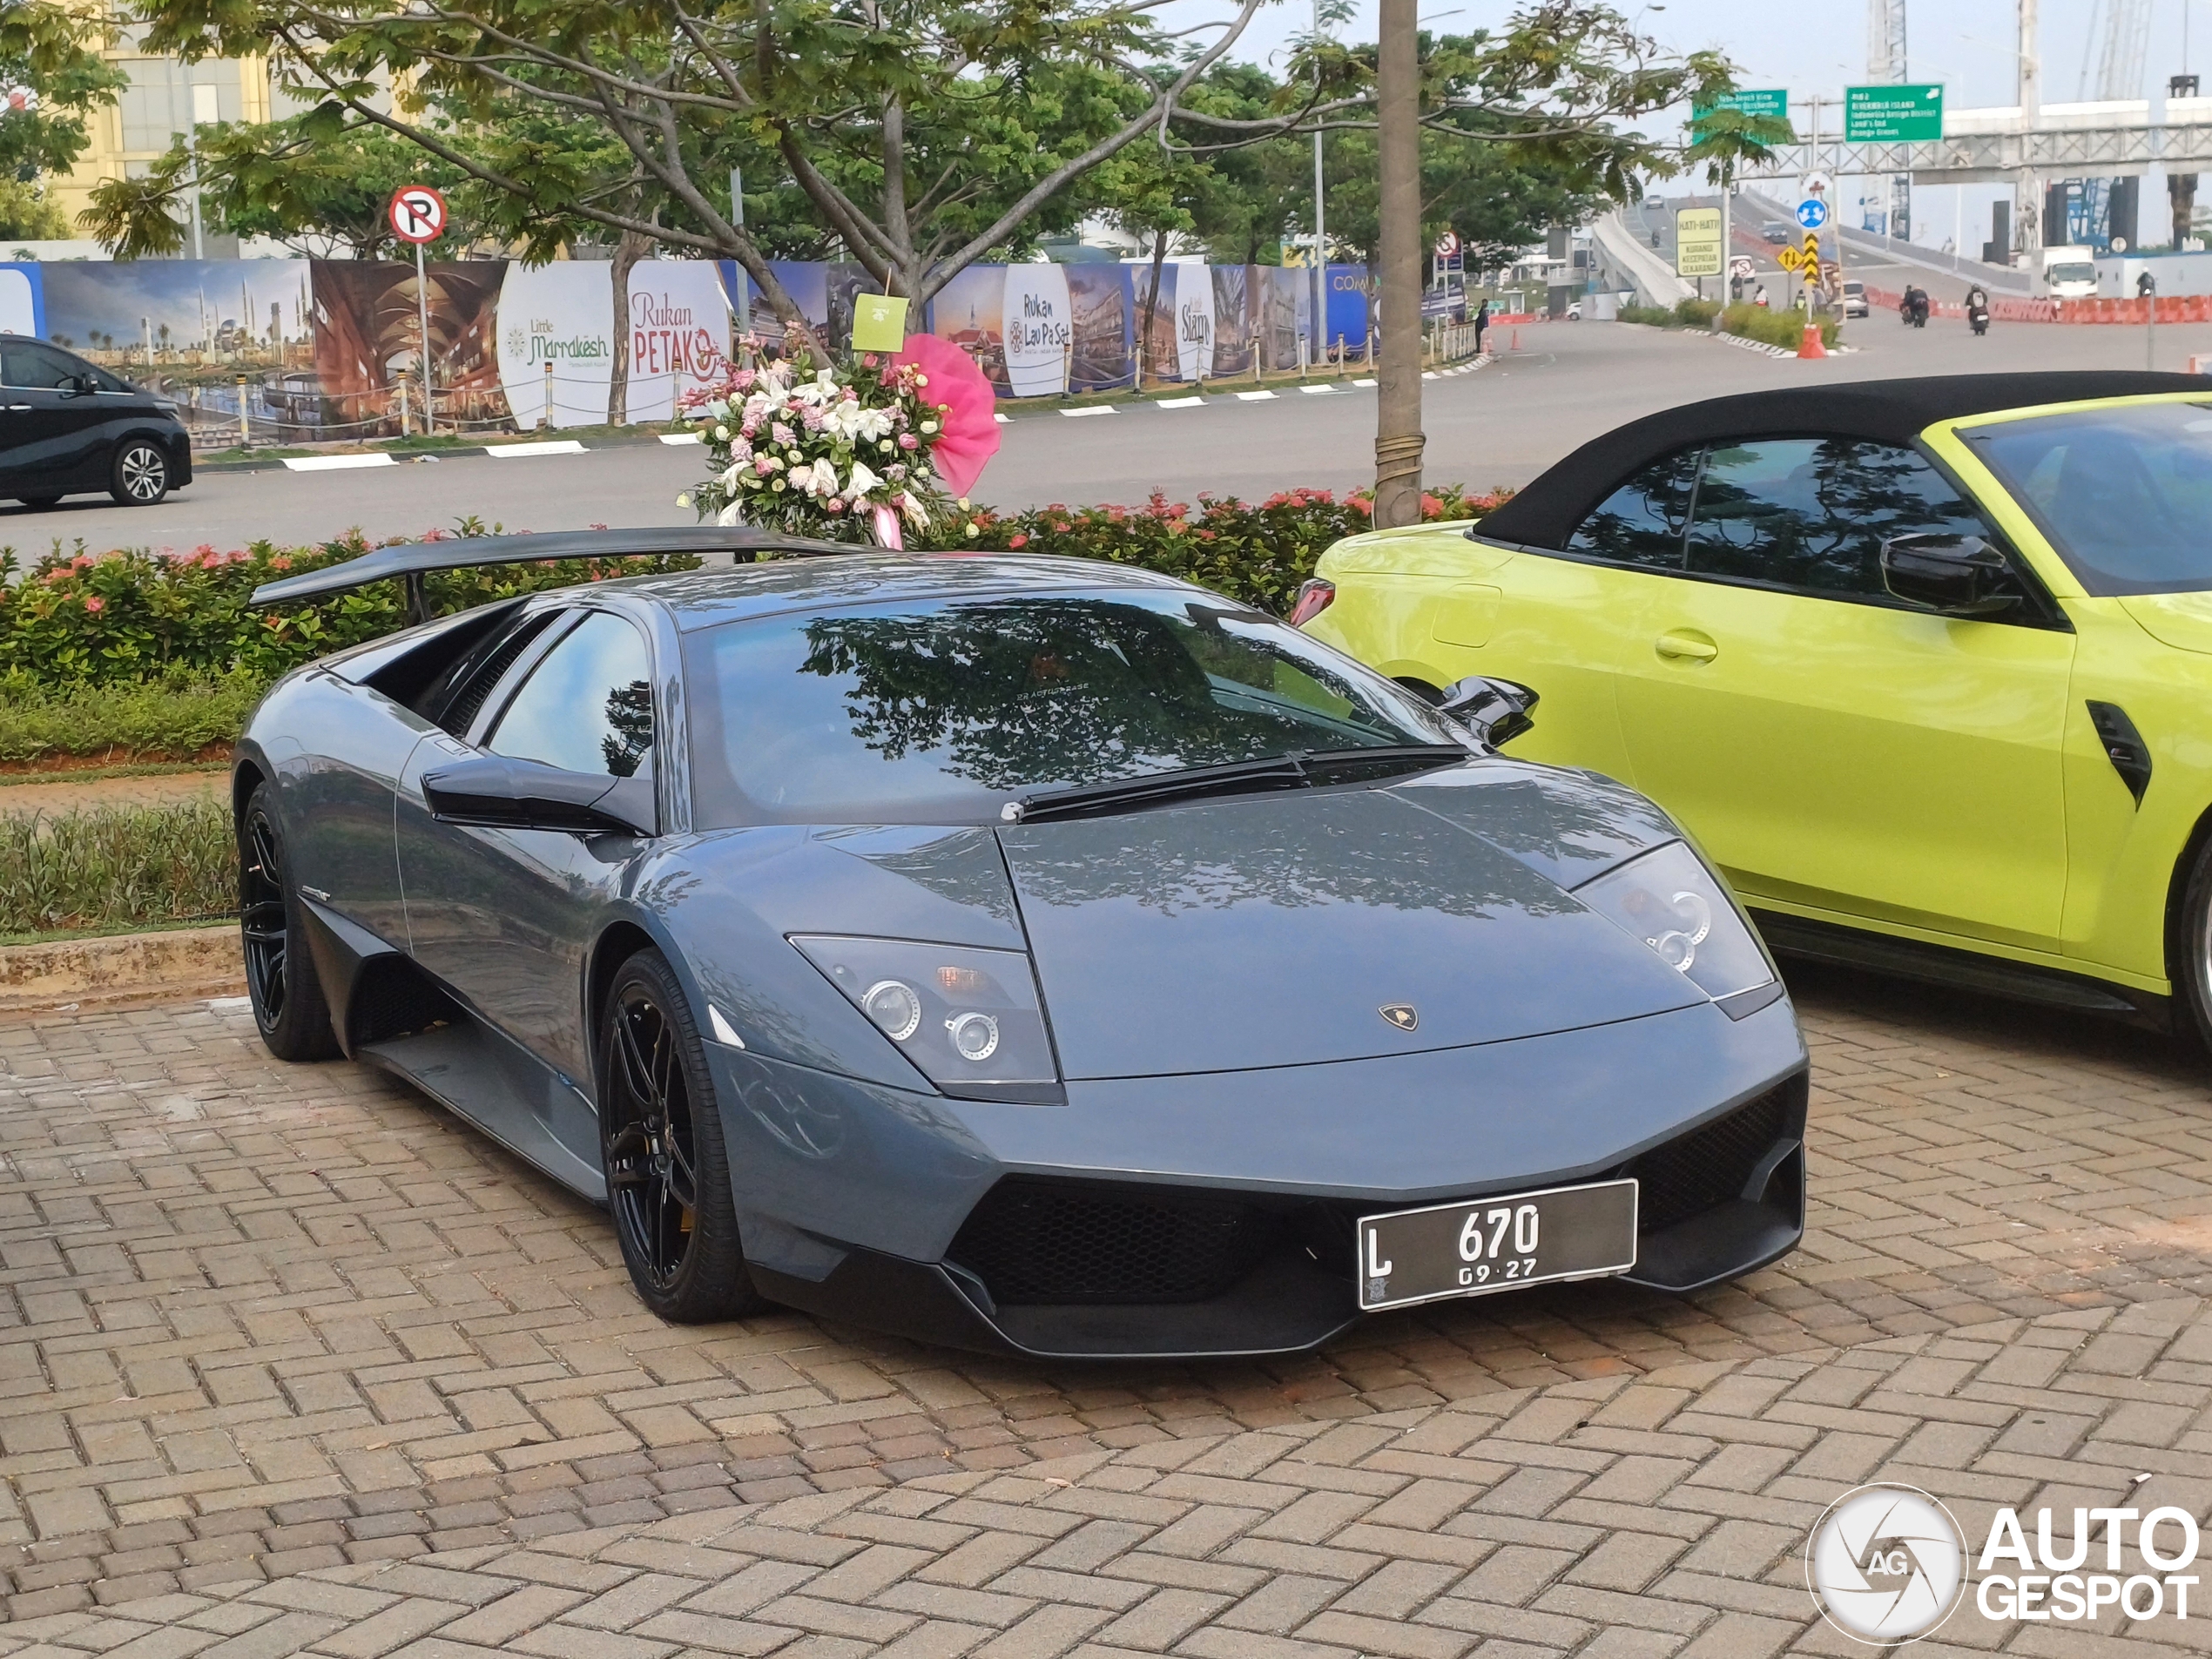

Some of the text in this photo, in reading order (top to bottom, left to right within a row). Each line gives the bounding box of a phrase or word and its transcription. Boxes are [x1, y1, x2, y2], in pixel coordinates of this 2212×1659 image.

[631, 292, 693, 328] Rukan
[1024, 293, 1053, 319] Rukan
[530, 319, 554, 333] Little
[1368, 1205, 1539, 1278] L 670
